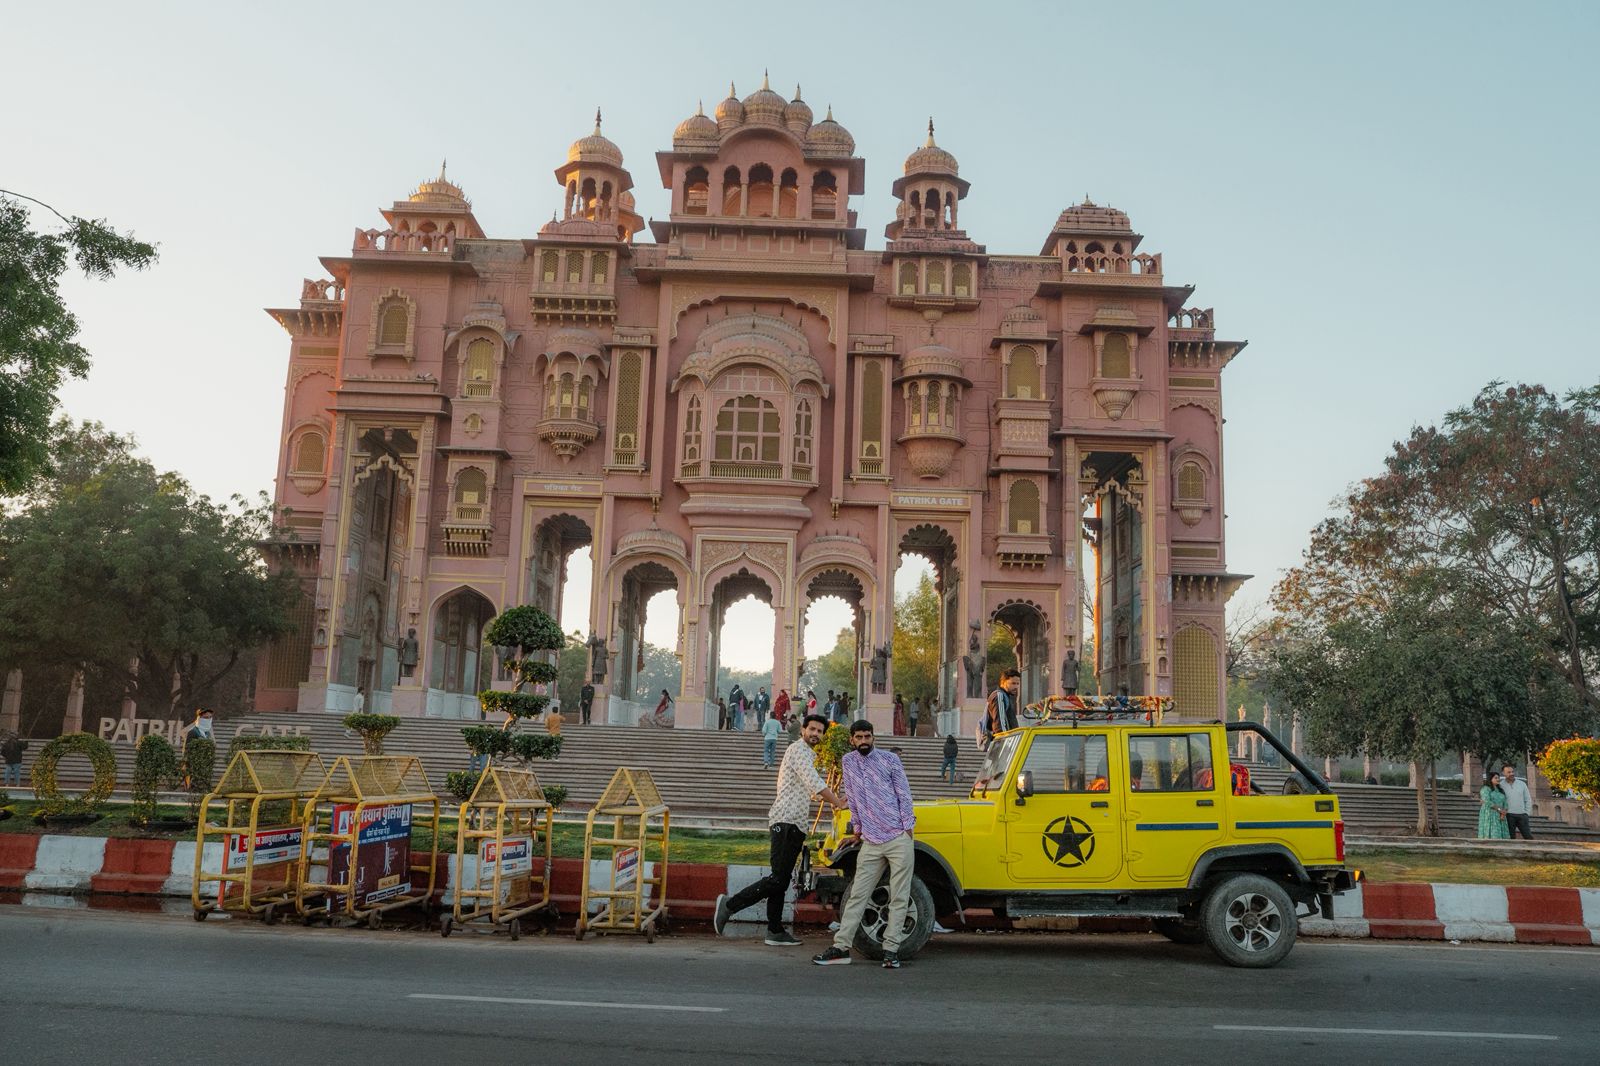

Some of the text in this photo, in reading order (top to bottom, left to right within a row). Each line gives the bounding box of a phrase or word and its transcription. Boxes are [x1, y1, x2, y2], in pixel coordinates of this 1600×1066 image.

[898, 496, 964, 506] PATRIKA GATE
[98, 717, 216, 745] PATRI
[348, 804, 402, 826] रस्थान पुलिस
[242, 836, 261, 850] पुस
